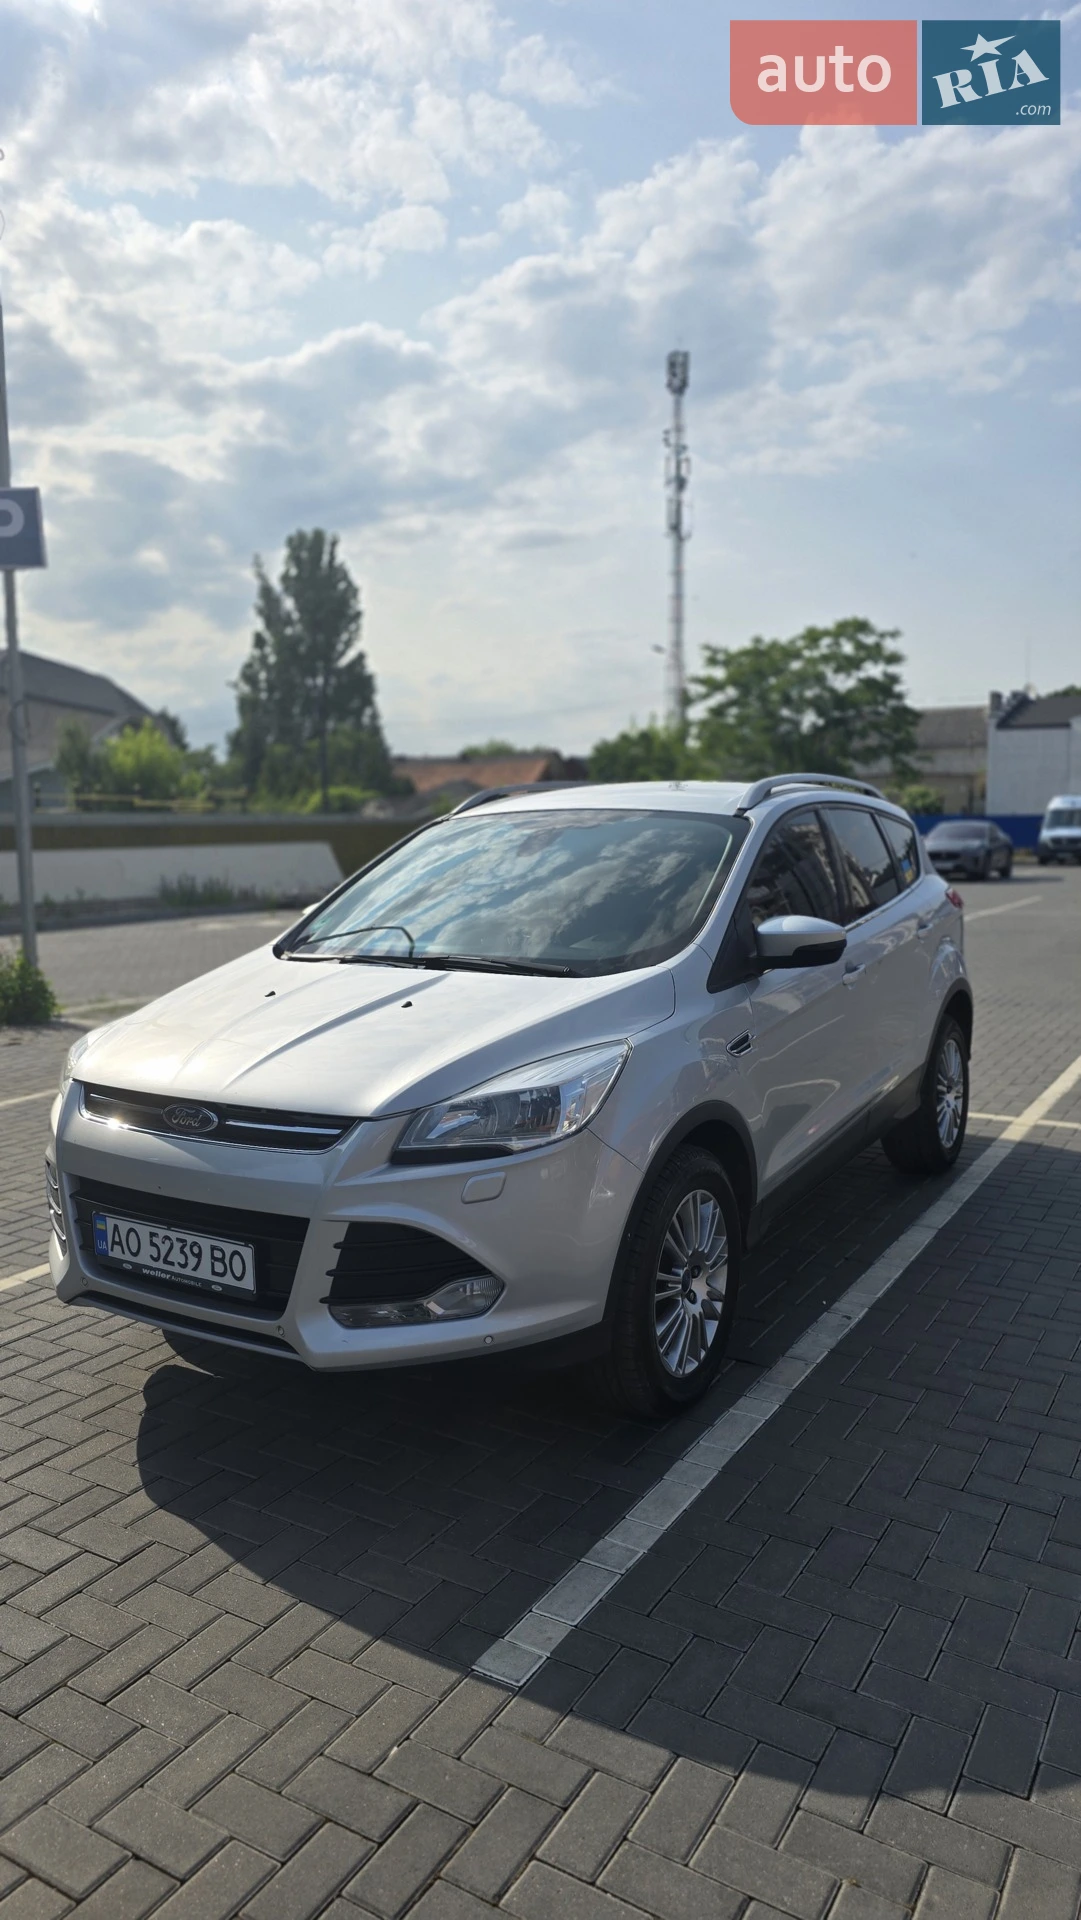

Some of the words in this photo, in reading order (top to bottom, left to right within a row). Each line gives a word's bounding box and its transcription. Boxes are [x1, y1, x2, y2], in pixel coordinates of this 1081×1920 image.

[171, 1107, 203, 1127] Ford
[97, 1239, 108, 1251] UA
[110, 1223, 142, 1258] AO
[148, 1231, 203, 1272] 5239
[210, 1244, 247, 1282] BO
